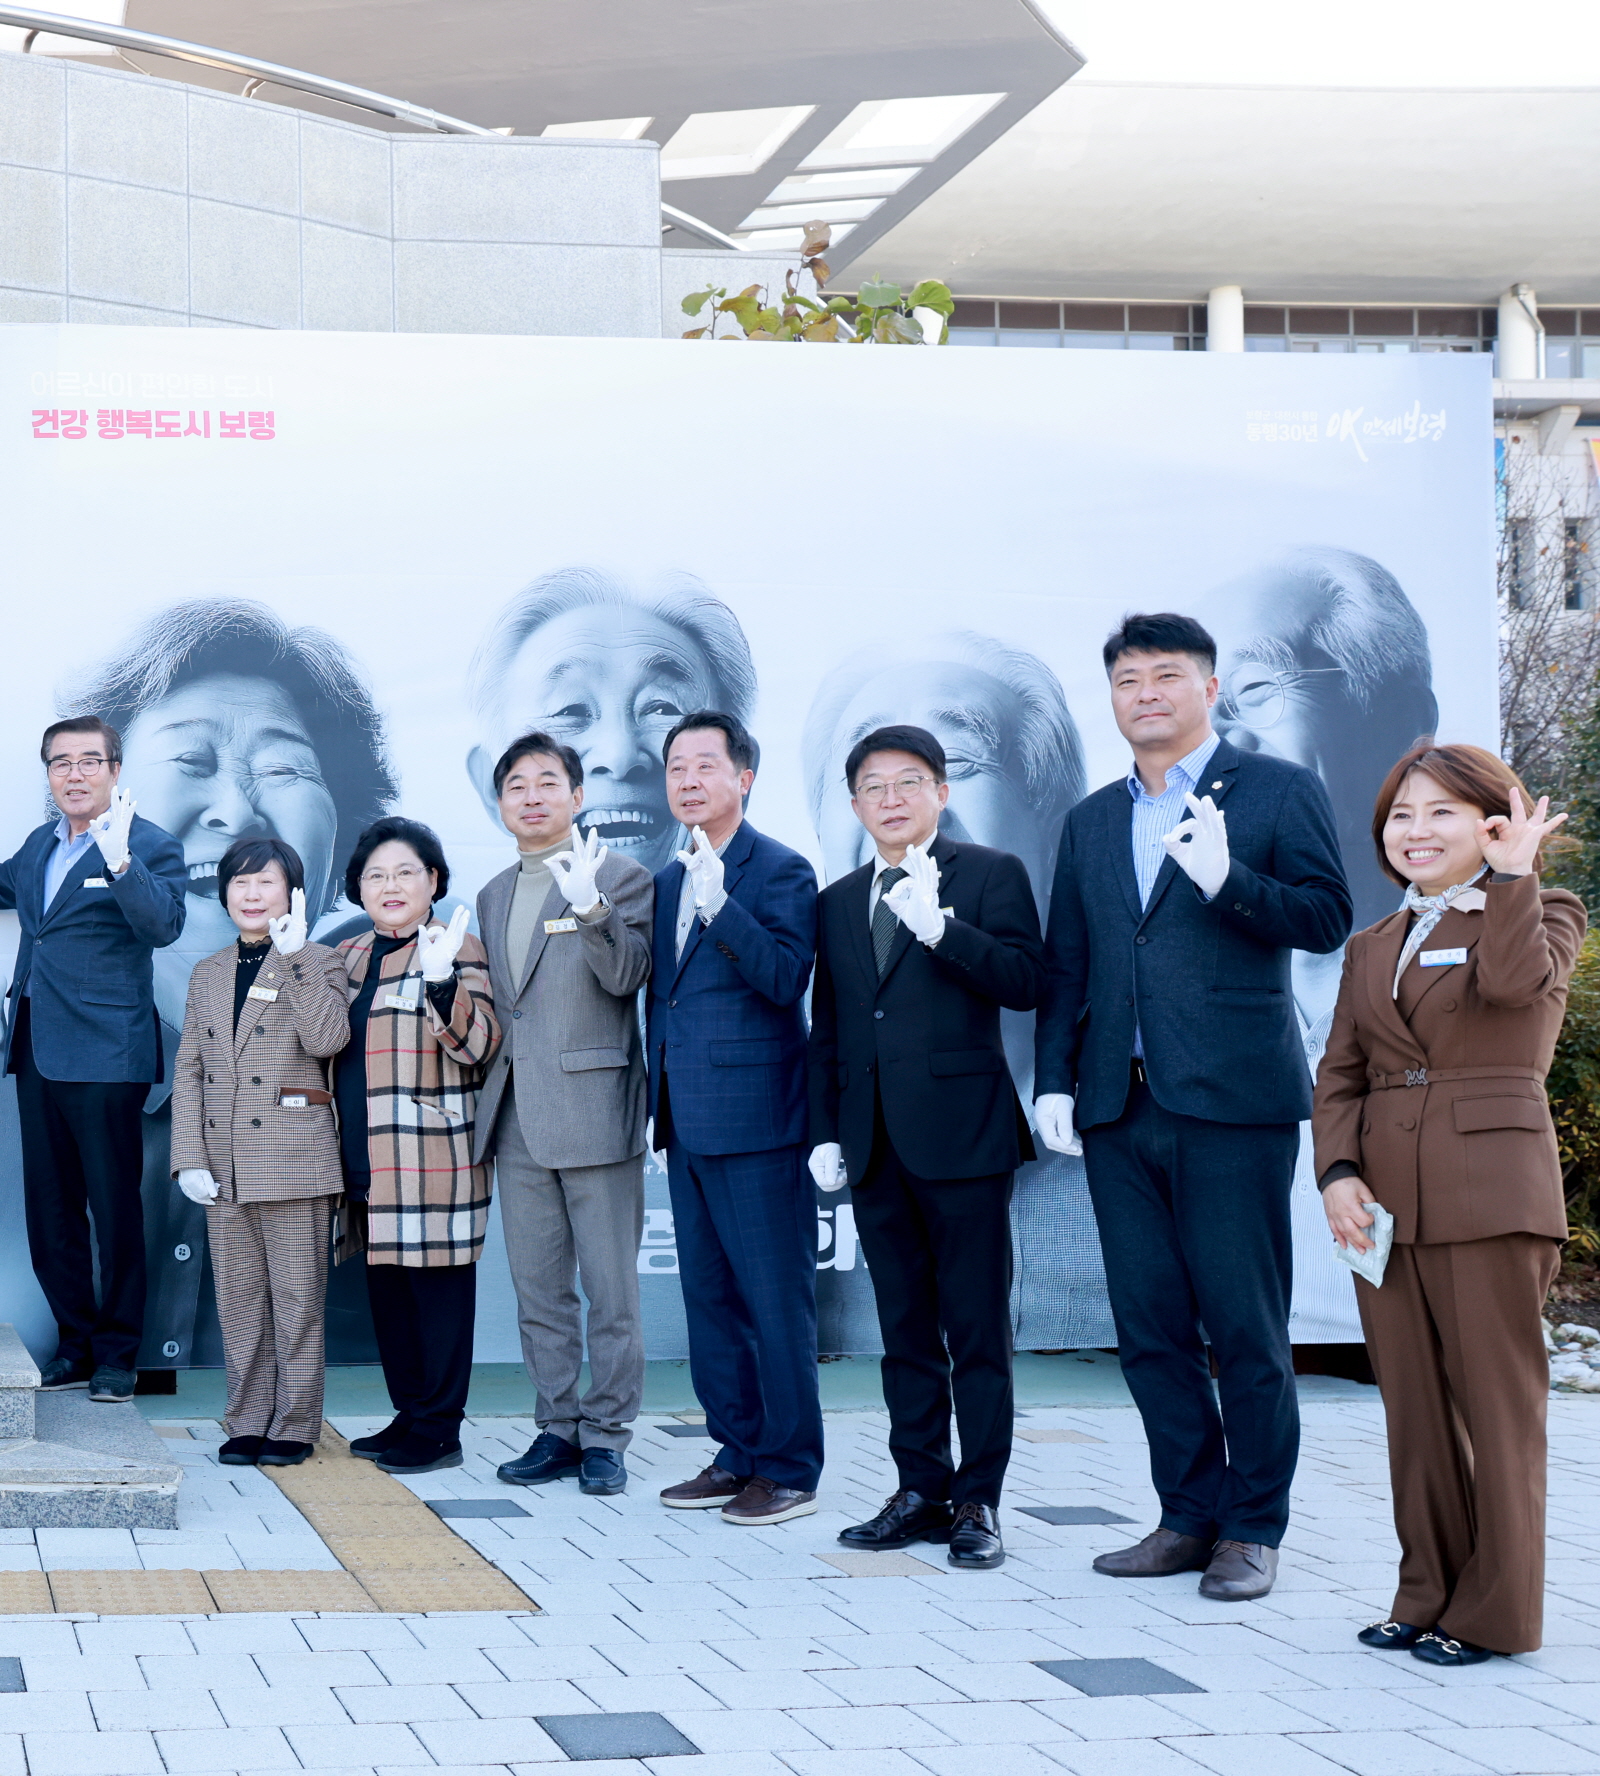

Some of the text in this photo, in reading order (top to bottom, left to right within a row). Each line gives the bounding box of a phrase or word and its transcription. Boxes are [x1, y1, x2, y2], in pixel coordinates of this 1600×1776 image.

[30, 371, 274, 399] 어르신이 편안한 도시
[31, 409, 276, 441] 건강 행복도시 보령
[1245, 423, 1319, 442] 동행30년
